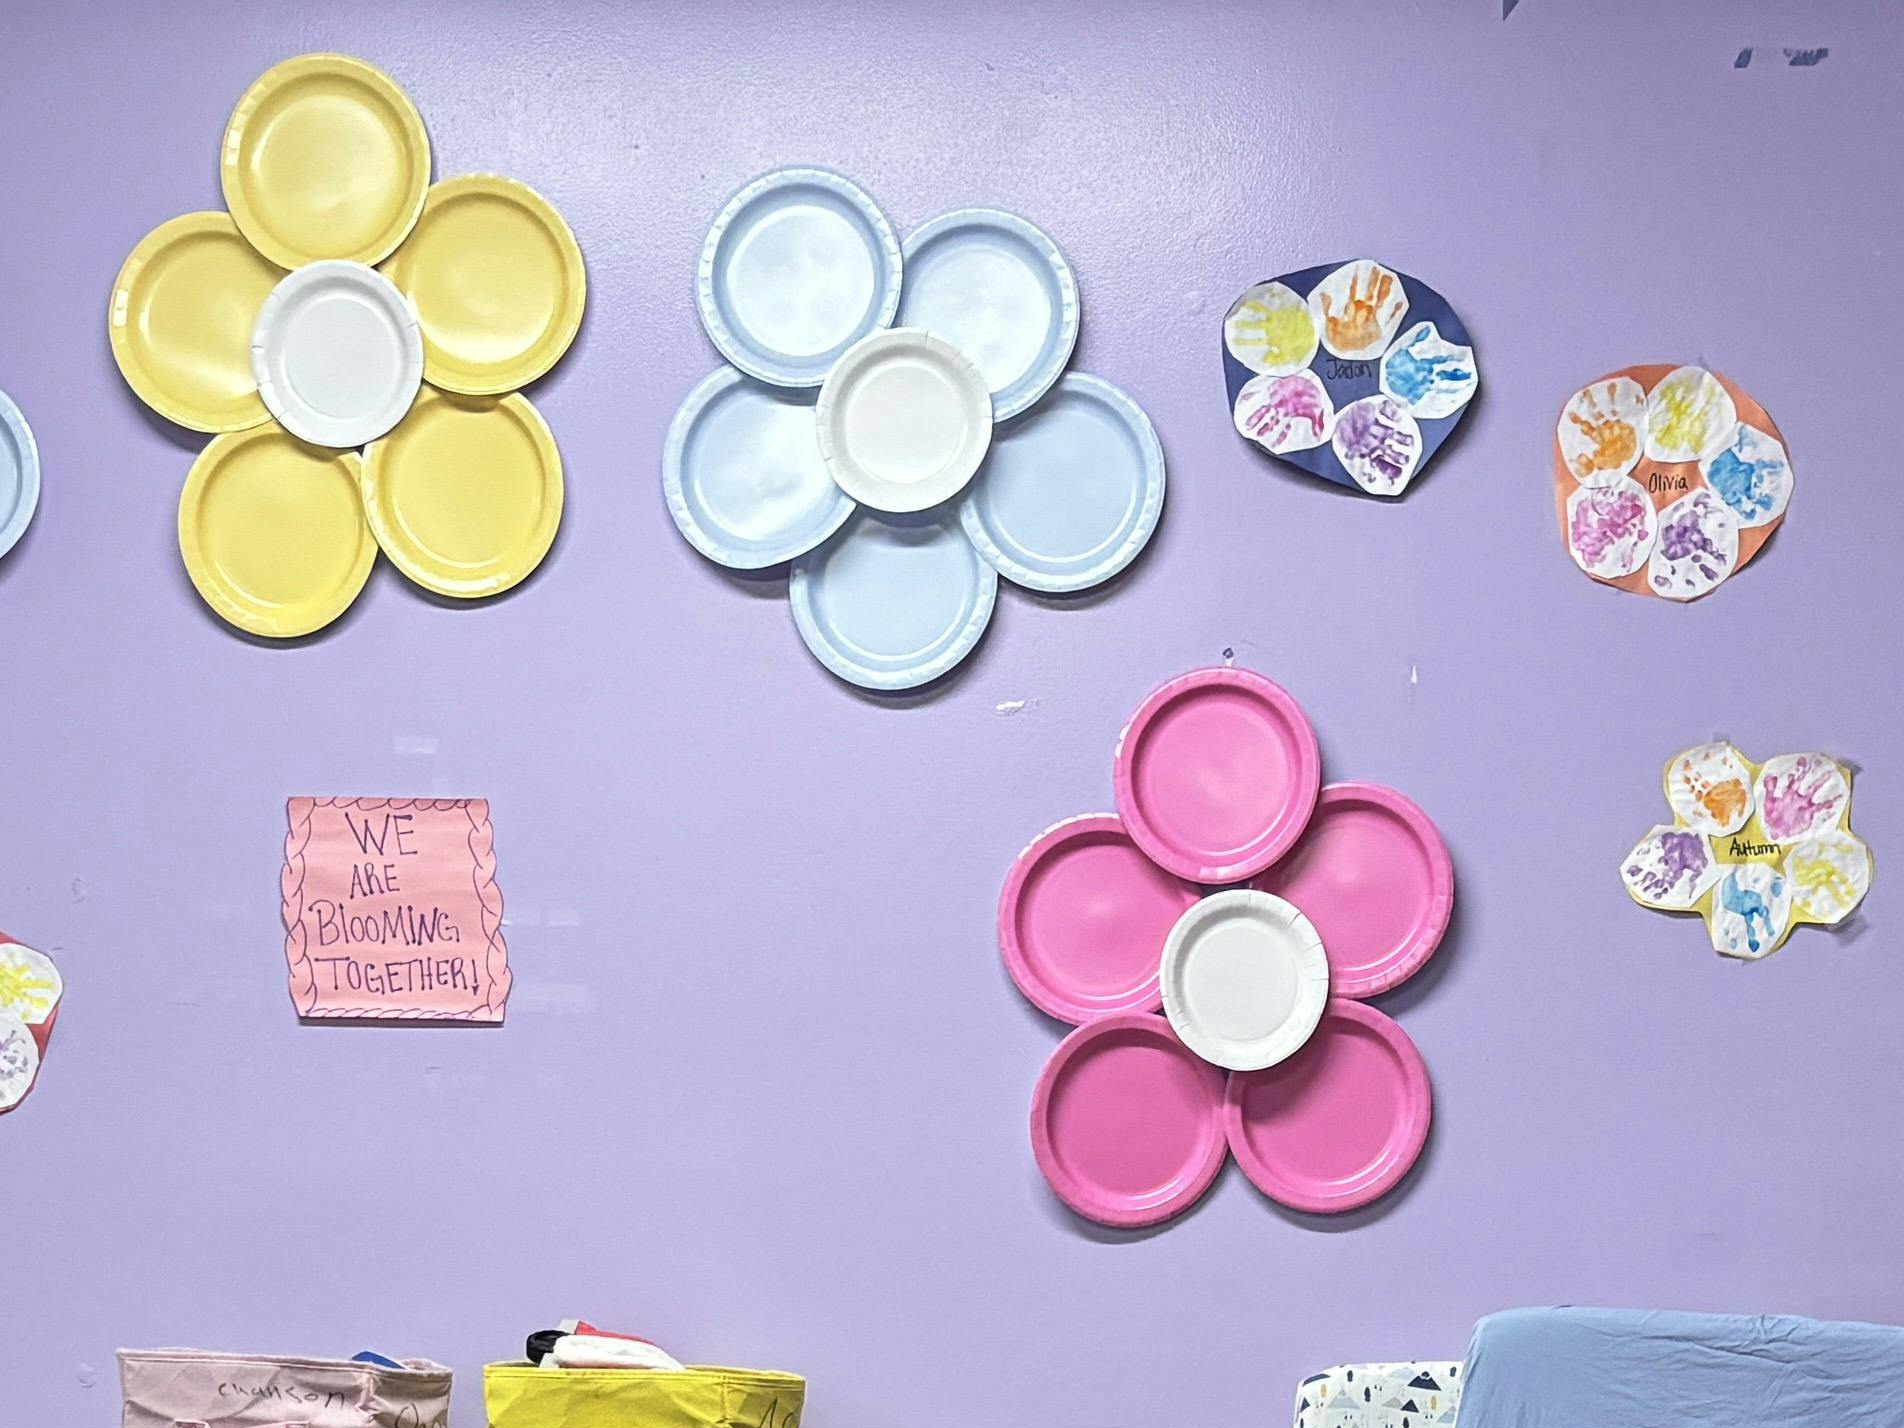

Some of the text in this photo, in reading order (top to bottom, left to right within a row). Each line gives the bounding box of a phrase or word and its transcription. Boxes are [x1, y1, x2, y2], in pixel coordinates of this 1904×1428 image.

[1649, 472, 1688, 494] Olivia
[345, 812, 418, 856] WE
[1729, 837, 1782, 857] Autumn
[349, 862, 400, 899] ARE
[314, 956, 481, 996] TOGETHER!
